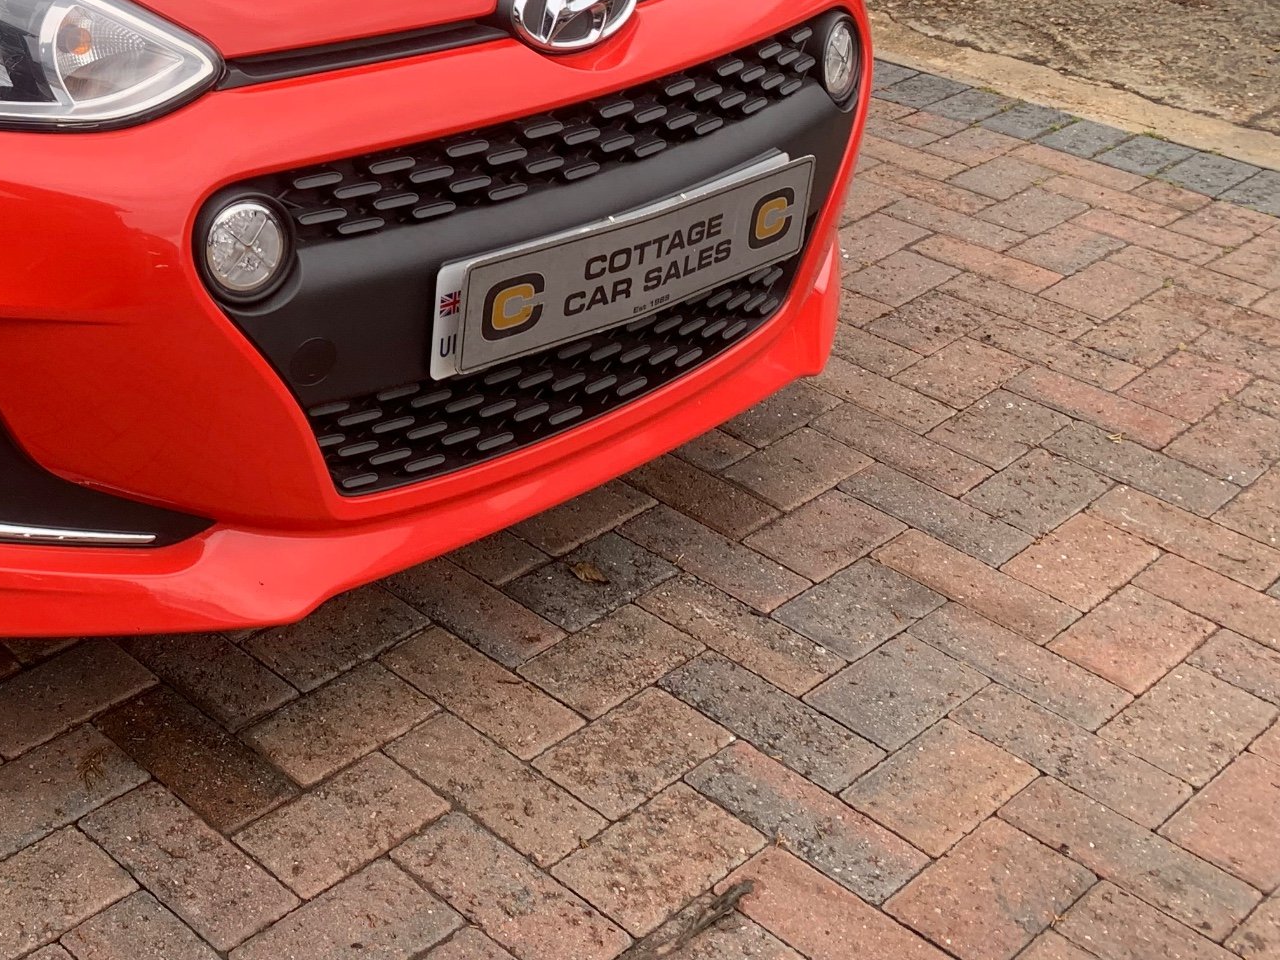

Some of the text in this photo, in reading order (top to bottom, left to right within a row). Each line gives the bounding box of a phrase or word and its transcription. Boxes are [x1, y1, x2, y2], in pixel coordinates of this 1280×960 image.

[563, 239, 732, 317] CAR SALES
[584, 213, 724, 281] COTTAGE
